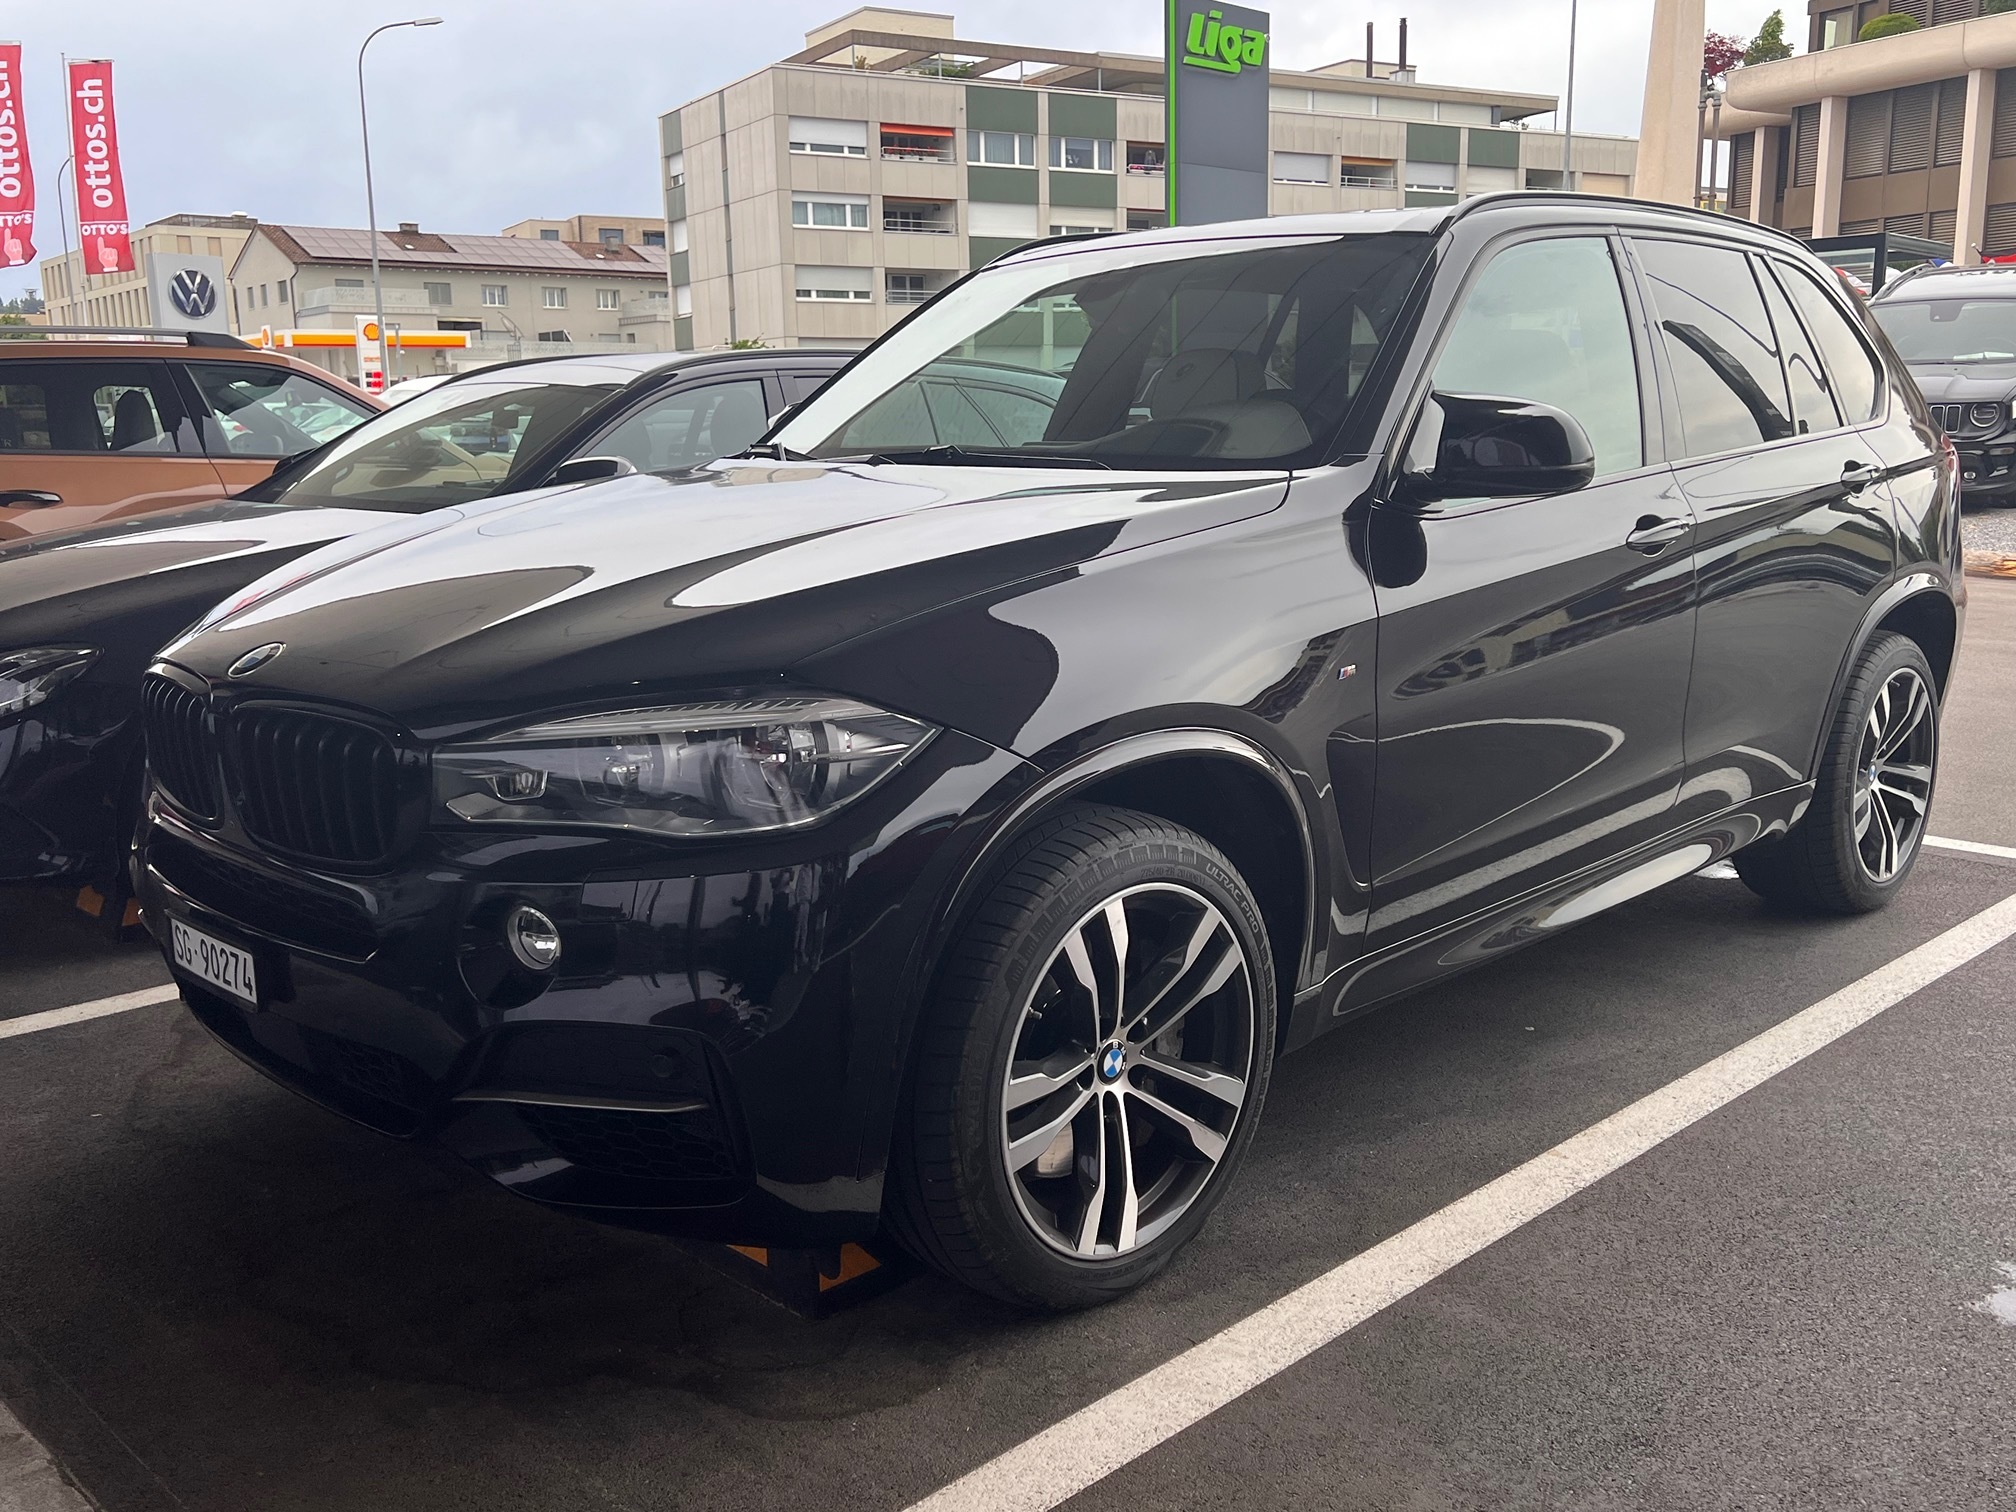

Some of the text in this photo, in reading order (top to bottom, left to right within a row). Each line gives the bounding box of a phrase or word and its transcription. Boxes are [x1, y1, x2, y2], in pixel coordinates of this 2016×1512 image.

[0, 60, 22, 198] ottos.c
[76, 78, 114, 208] ottos.ch
[0, 213, 33, 228] TTO'S
[81, 223, 128, 236] OTTO'S
[169, 267, 216, 318] VW
[1205, 863, 1260, 933] ULTRAC PRO
